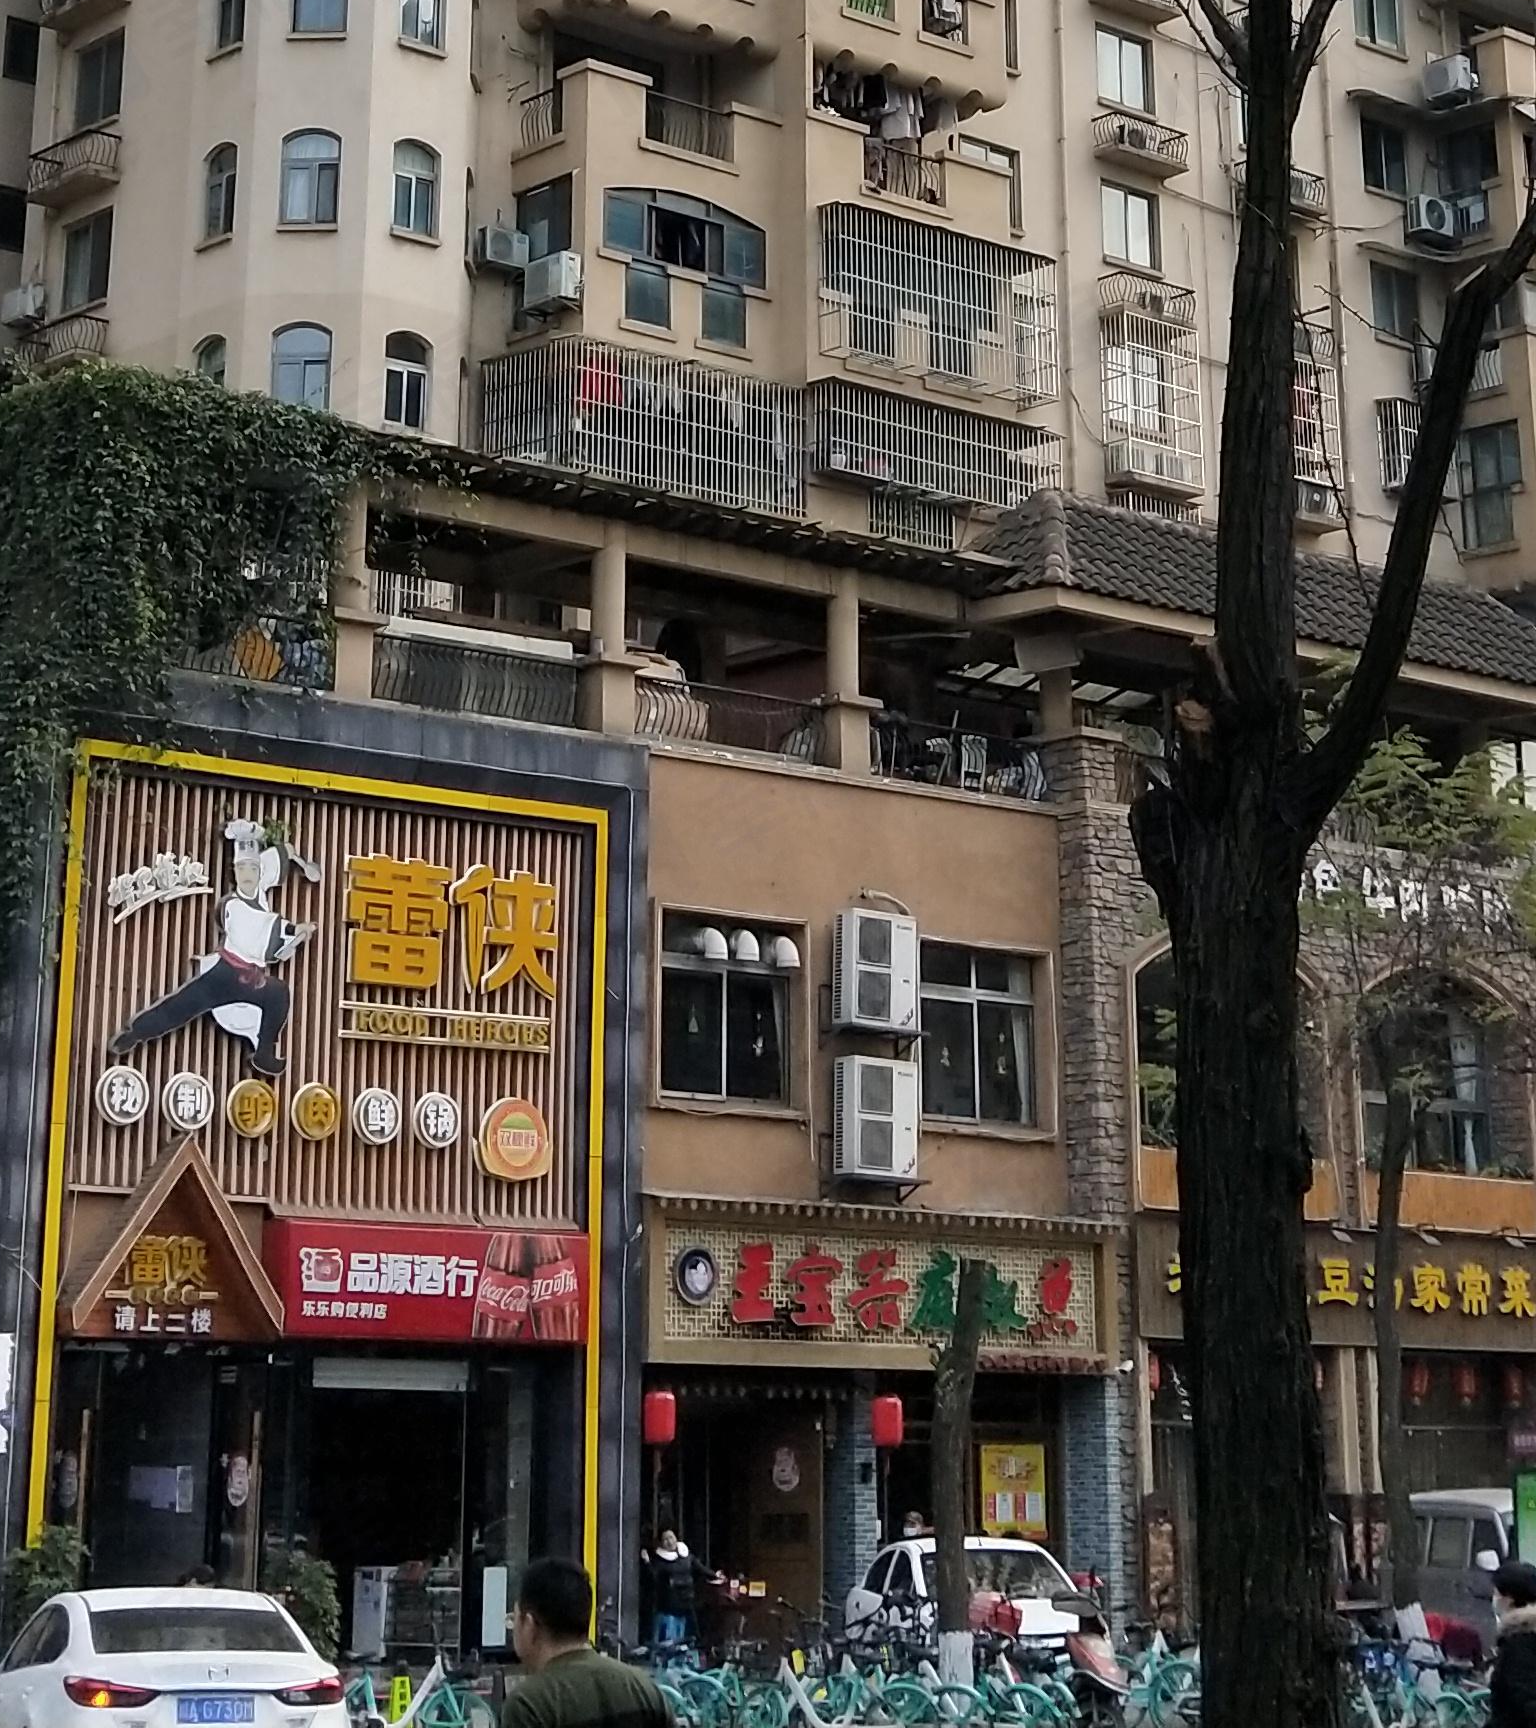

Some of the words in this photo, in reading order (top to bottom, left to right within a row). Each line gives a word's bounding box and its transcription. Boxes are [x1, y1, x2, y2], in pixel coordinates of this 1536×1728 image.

[355, 1009, 429, 1038] FOOD
[448, 1017, 549, 1046] HEROES
[346, 1252, 479, 1299] 品源酒行
[114, 1304, 212, 1334] 请上二楼
[300, 1299, 389, 1321] 乐乐购便利店
